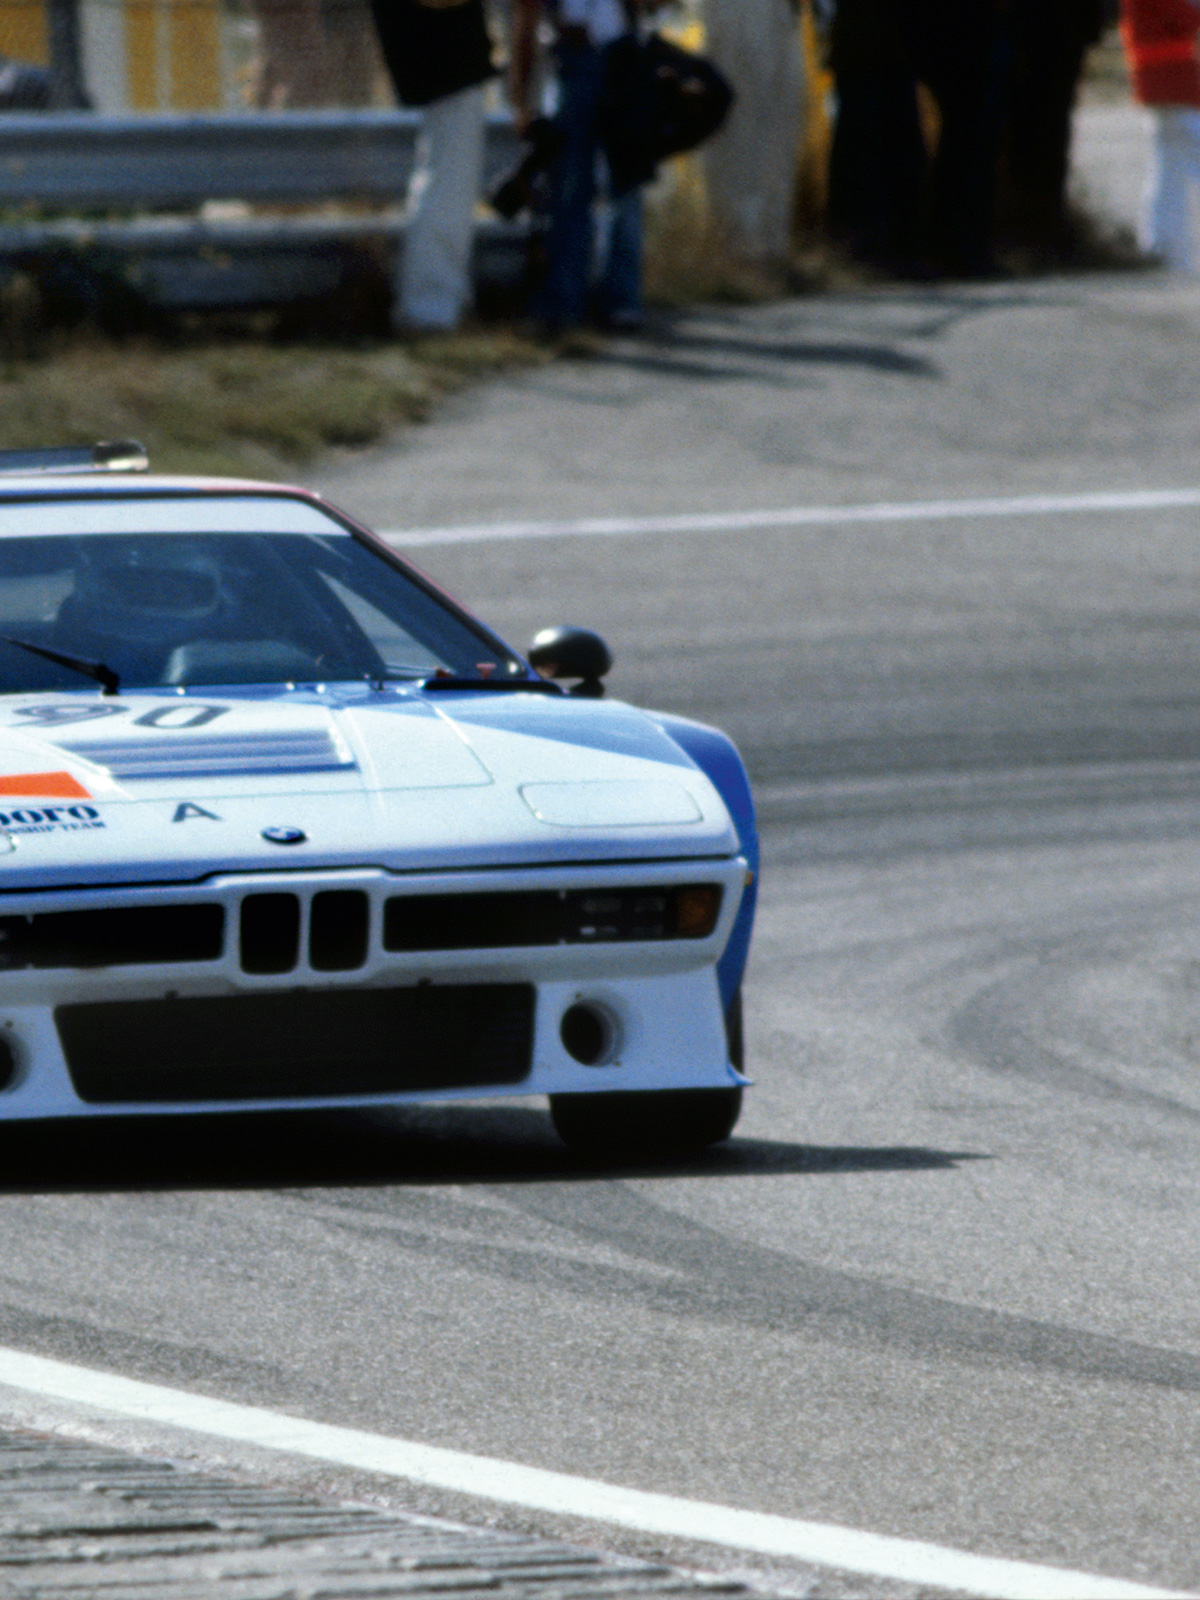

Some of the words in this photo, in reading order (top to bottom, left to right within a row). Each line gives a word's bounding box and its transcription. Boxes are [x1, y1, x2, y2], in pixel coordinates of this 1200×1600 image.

[10, 703, 230, 729] 90
[172, 802, 223, 822] A
[63, 821, 106, 833] TEAM
